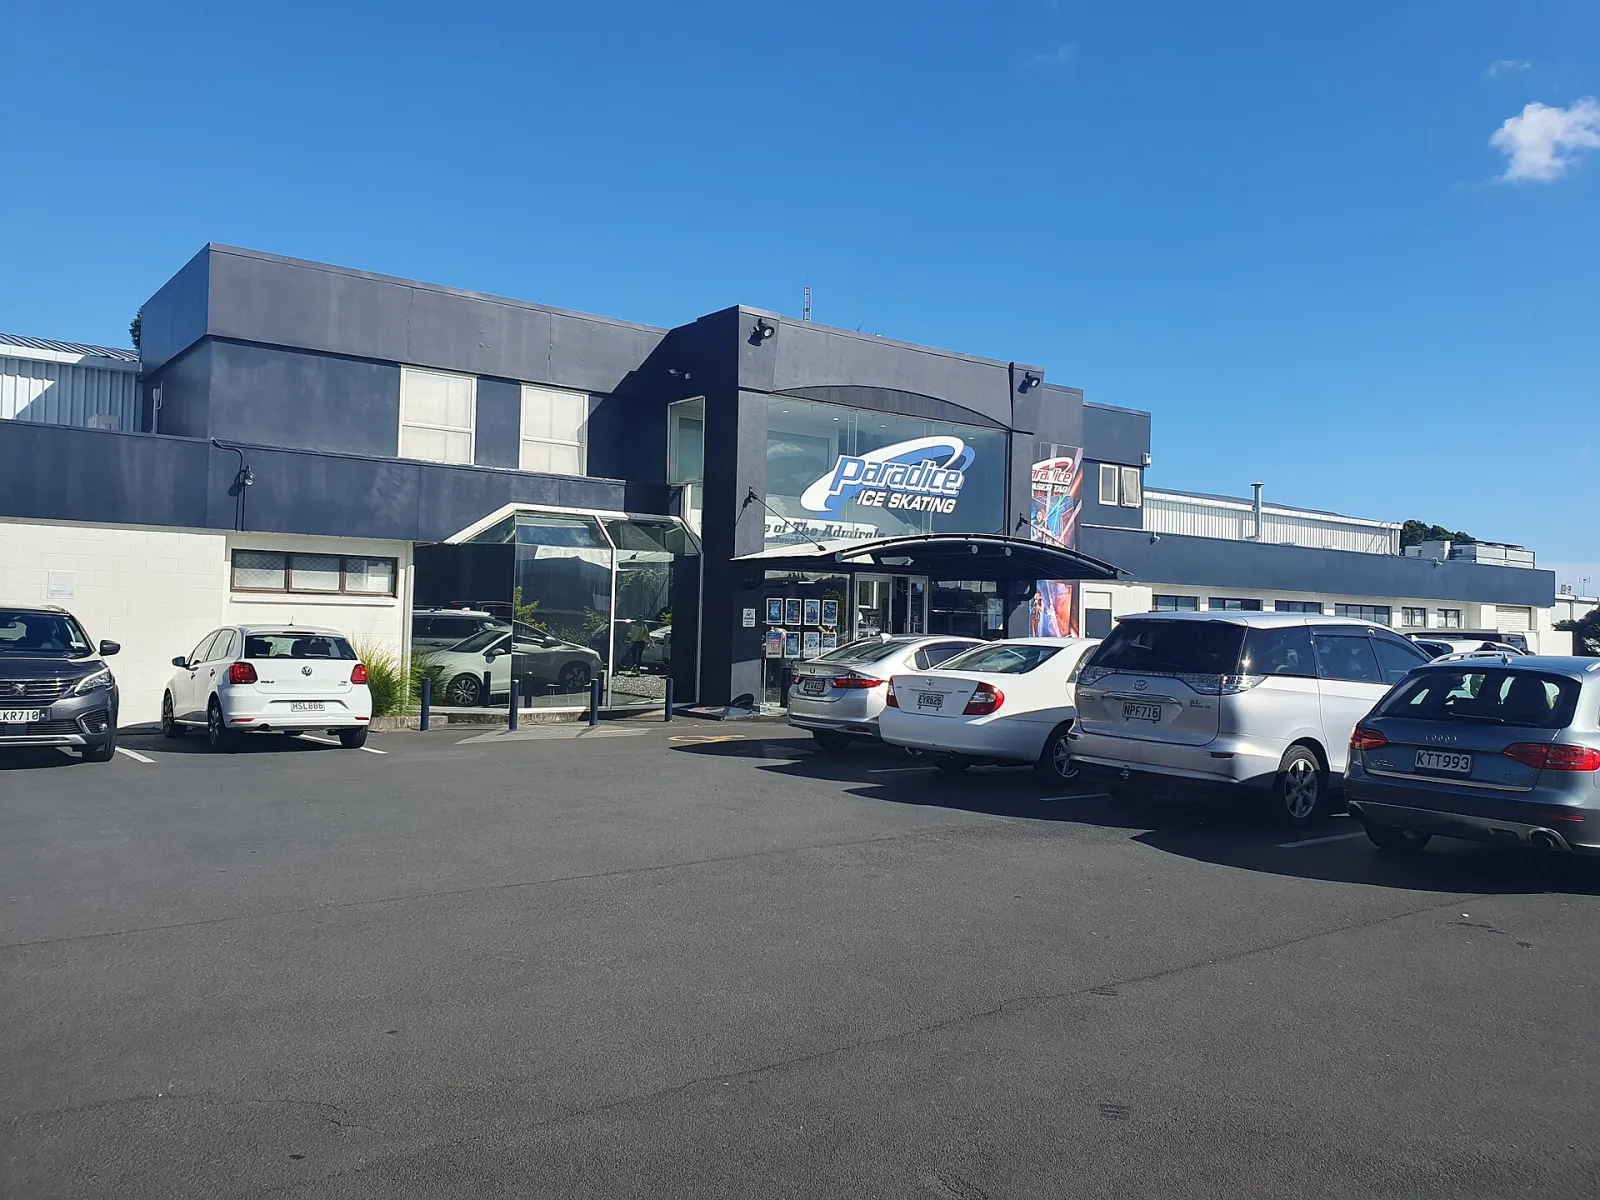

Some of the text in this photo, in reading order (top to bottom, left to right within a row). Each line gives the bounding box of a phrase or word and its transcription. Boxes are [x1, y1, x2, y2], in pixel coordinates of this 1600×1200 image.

[828, 455, 965, 496] Paradice
[856, 489, 956, 514] ICE SKATING
[773, 521, 787, 533] of
[792, 521, 818, 537] The
[1123, 703, 1160, 718] NPF716
[1416, 751, 1470, 771] KTT993
